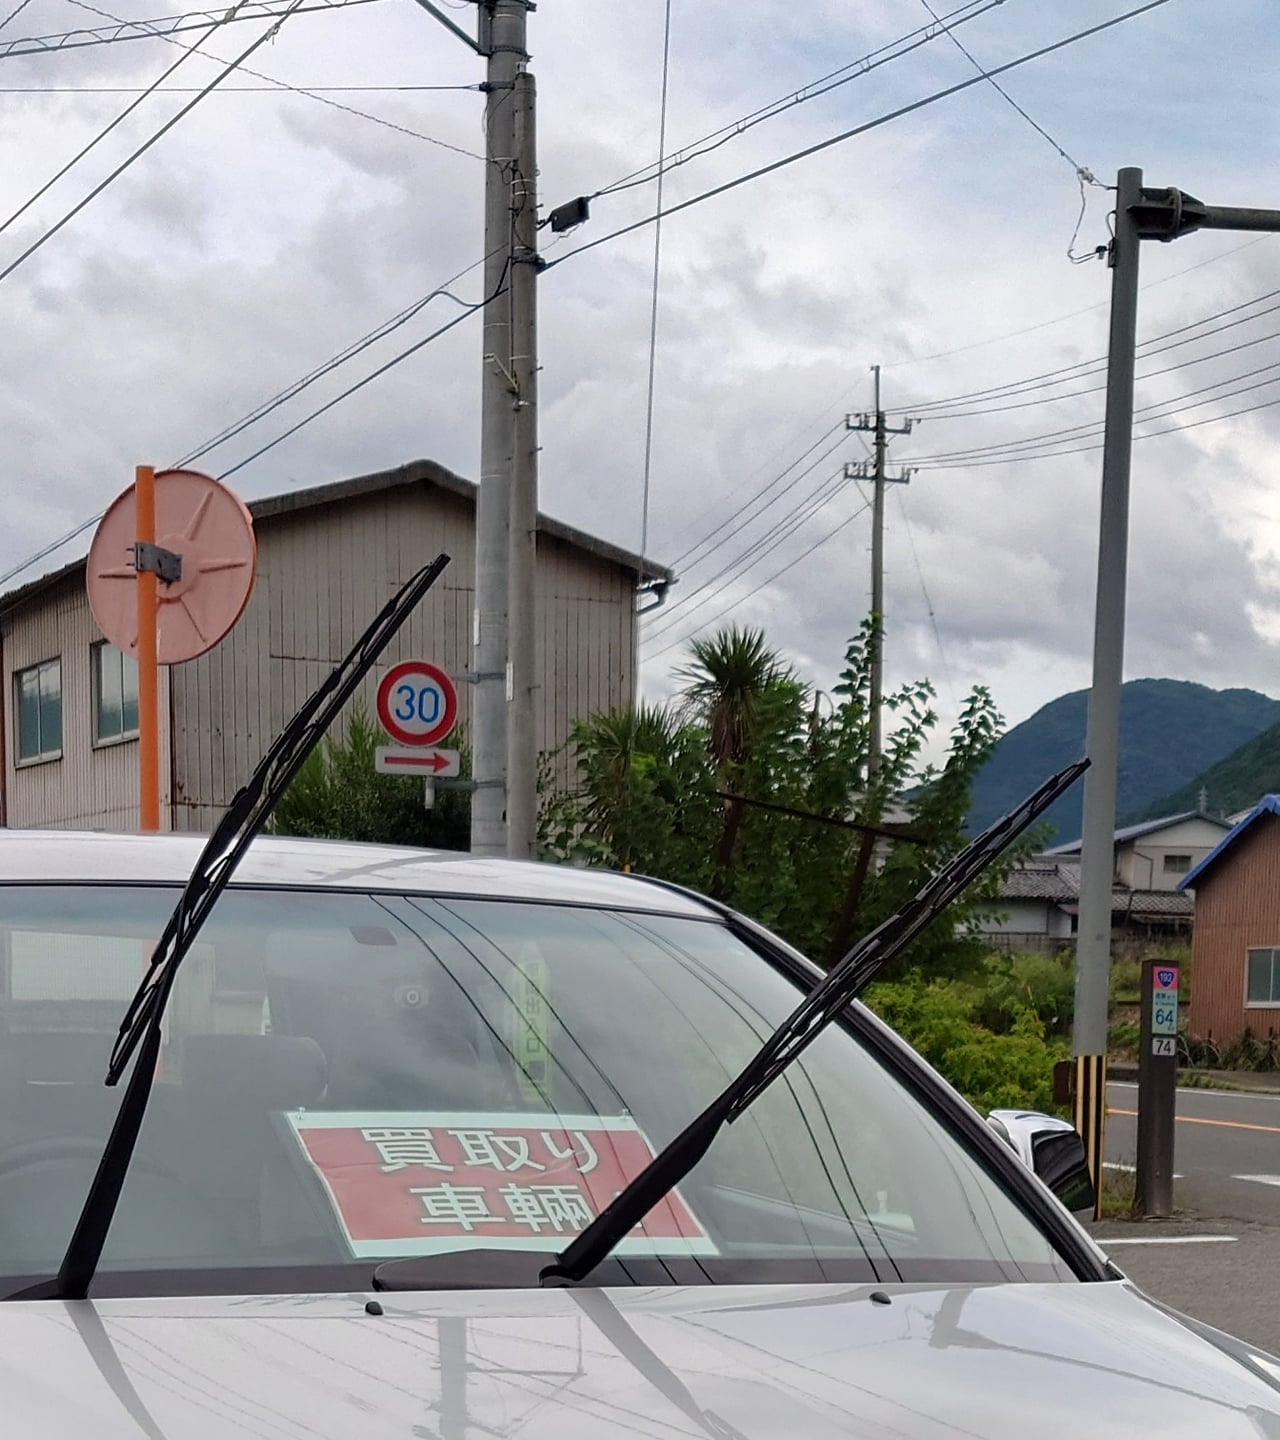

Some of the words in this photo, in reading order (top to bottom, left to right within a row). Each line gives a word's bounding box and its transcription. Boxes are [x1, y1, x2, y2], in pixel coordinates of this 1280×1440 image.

[395, 685, 439, 723] 30
[1155, 1008, 1173, 1025] 64
[1156, 1039, 1172, 1055] 74
[360, 1128, 599, 1174] 買取り
[409, 1182, 643, 1233] 車輛
